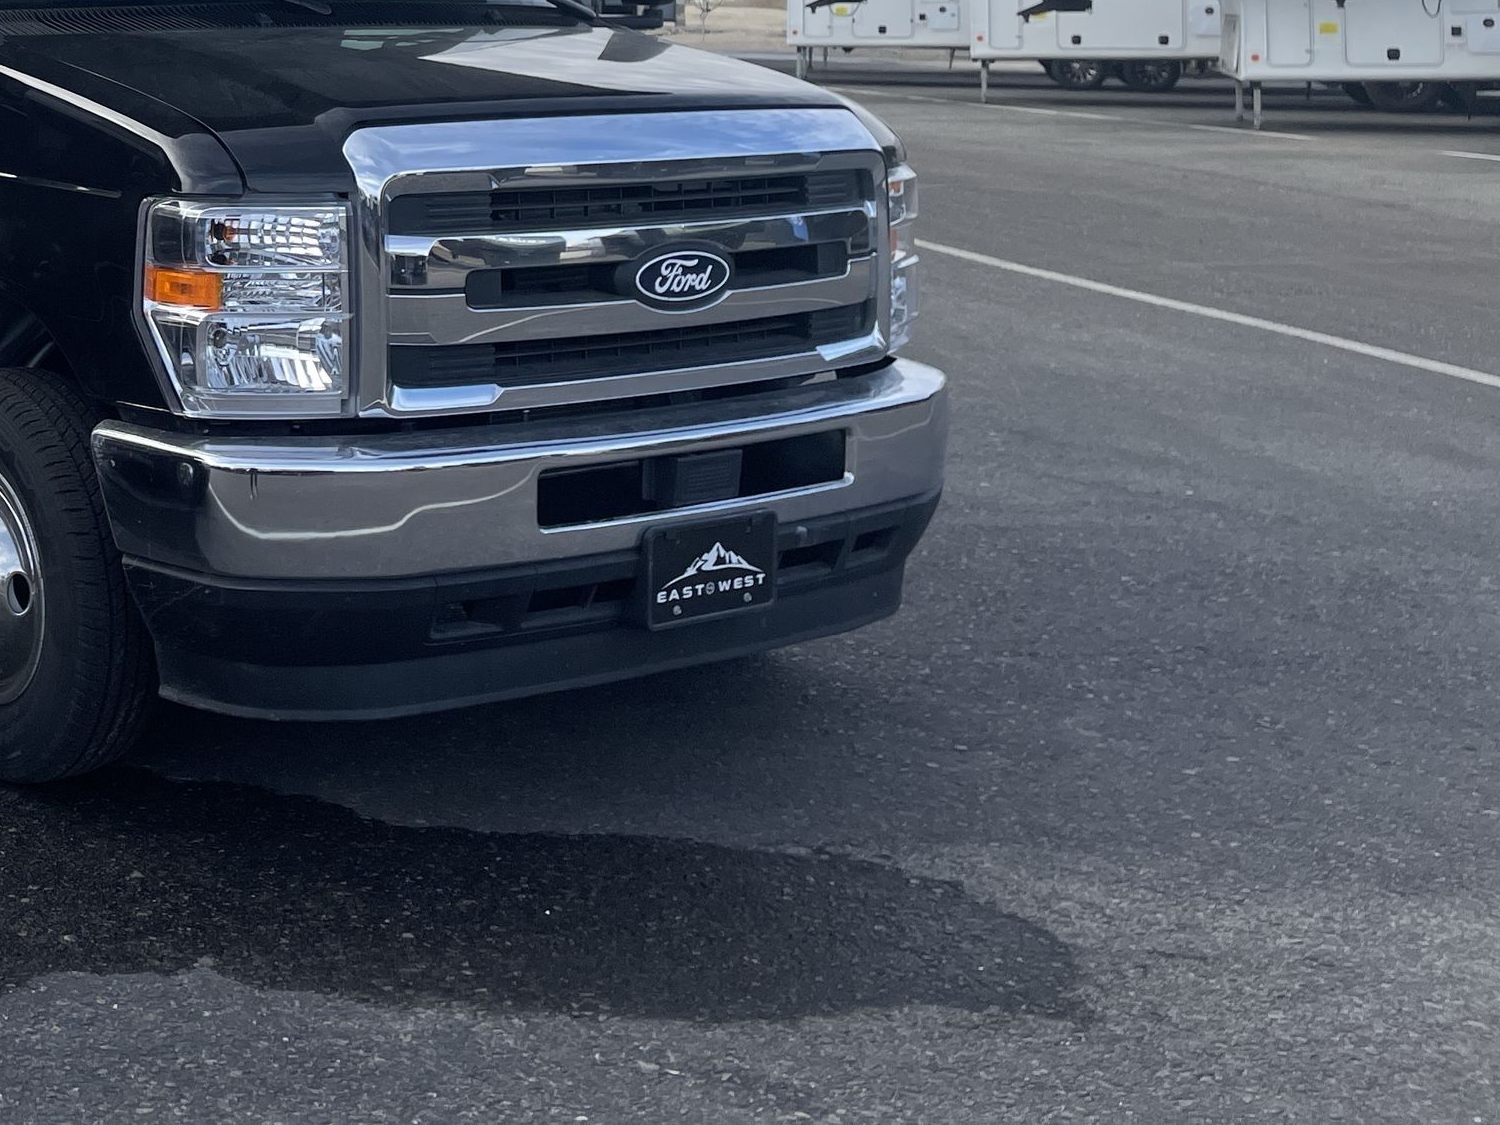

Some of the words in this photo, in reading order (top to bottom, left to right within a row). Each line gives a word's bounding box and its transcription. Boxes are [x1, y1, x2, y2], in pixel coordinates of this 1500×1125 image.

[654, 258, 713, 294] Ford
[656, 583, 706, 604] EAST
[717, 573, 767, 592] WEST
